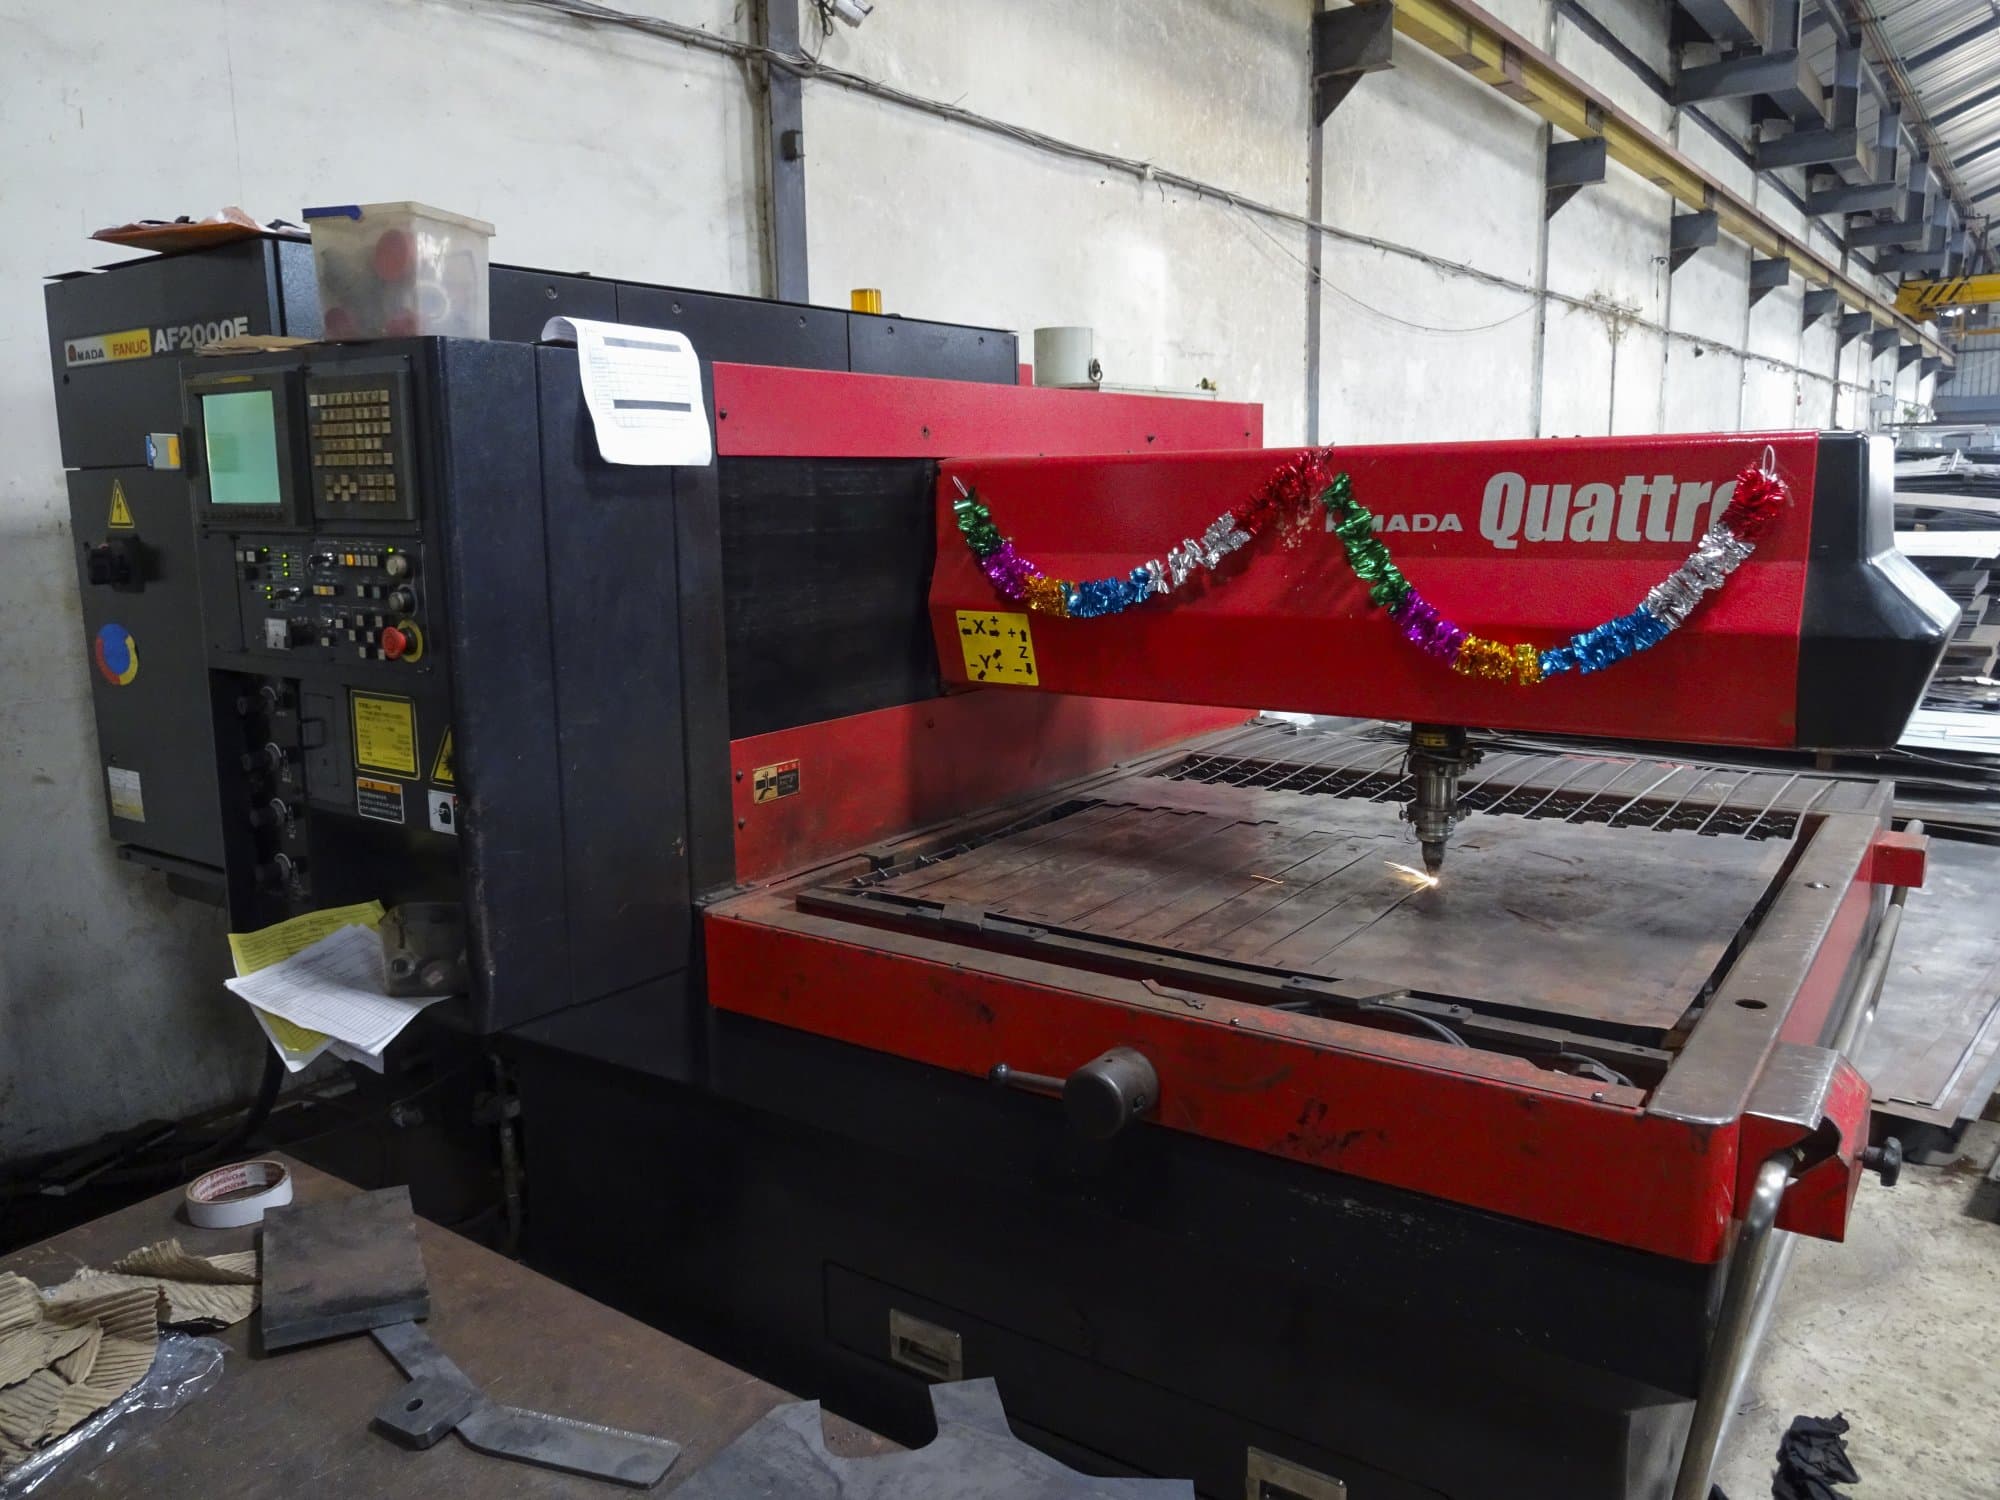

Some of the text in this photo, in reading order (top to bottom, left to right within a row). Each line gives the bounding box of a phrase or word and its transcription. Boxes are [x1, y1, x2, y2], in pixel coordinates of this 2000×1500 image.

[112, 339, 148, 356] FANUC
[1325, 511, 1463, 533] ADA
[973, 619, 986, 634] X
[1018, 646, 1028, 658] Z
[979, 654, 990, 669] Y
